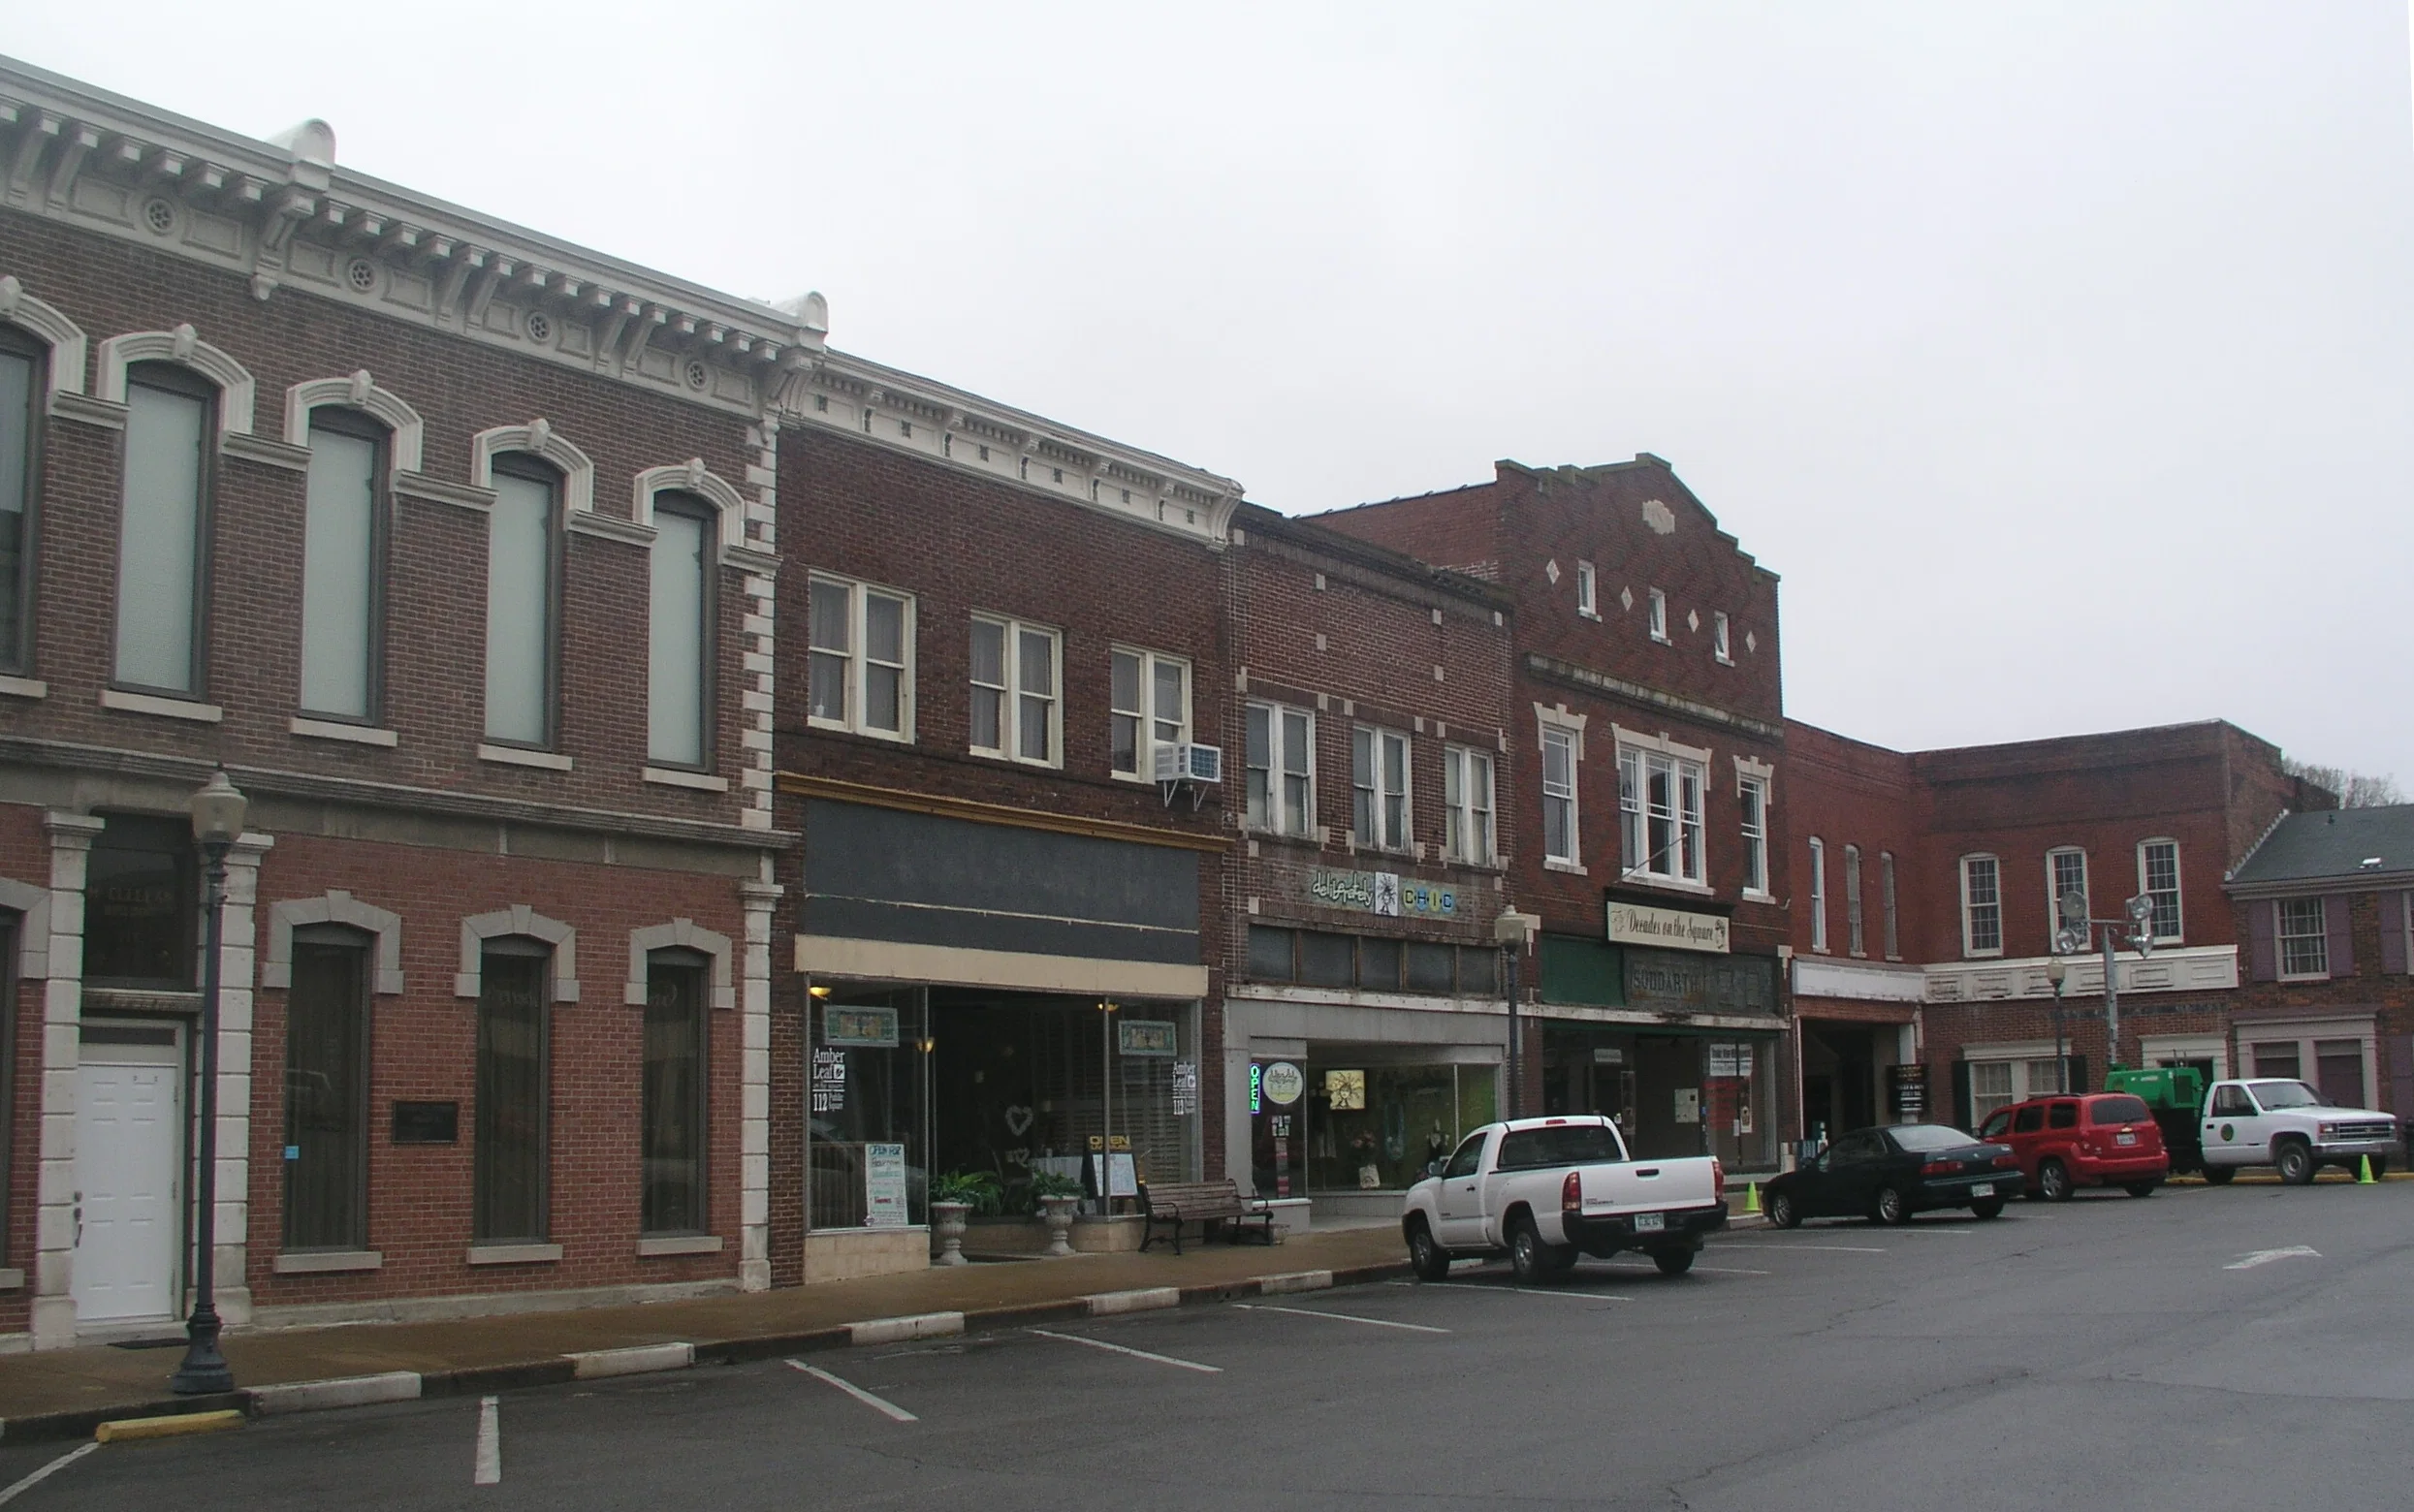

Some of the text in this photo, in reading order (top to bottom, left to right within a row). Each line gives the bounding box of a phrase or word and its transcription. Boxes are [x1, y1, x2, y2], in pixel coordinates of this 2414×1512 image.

[1628, 909, 1713, 943] Decades on the Square
[812, 1047, 845, 1063] Amber
[812, 1063, 834, 1080] Leaf
[1250, 1065, 1259, 1111] OPEN
[813, 1092, 827, 1112] 112
